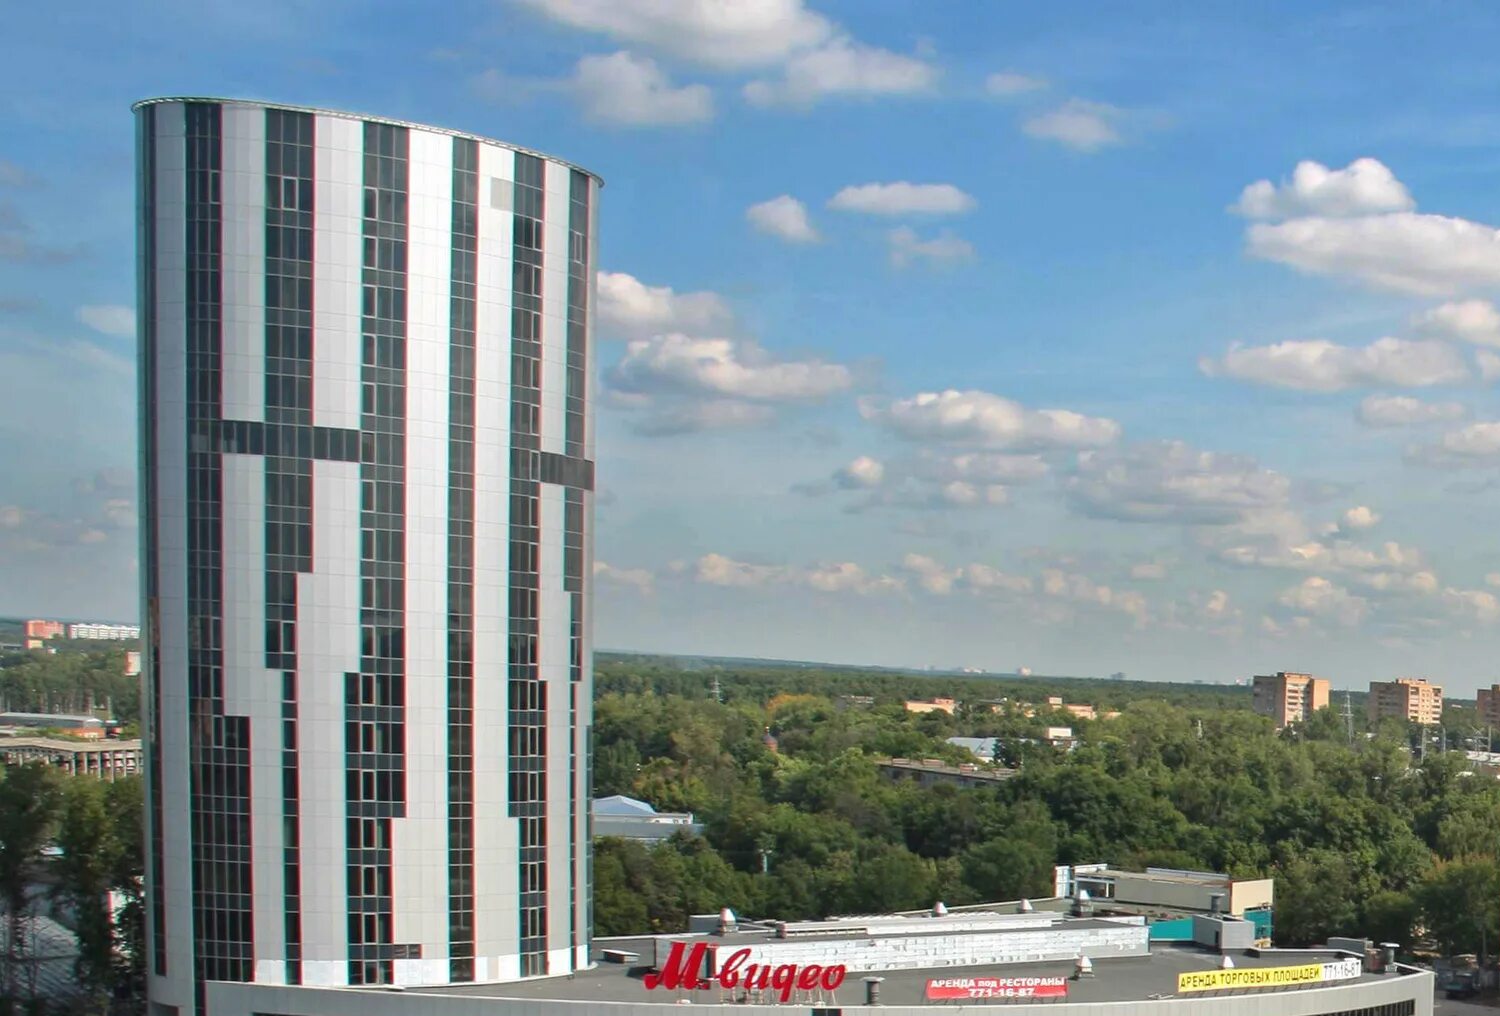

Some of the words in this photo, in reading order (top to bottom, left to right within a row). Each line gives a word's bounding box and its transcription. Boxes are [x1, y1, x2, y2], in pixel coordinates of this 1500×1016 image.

[930, 979, 975, 989] АРЕНДА
[978, 980, 998, 988] под
[1000, 977, 1065, 987] РЕСТОРАНЫ
[1180, 975, 1217, 987] АРЕНДА
[1220, 971, 1271, 985] ТОРГОВЫХ
